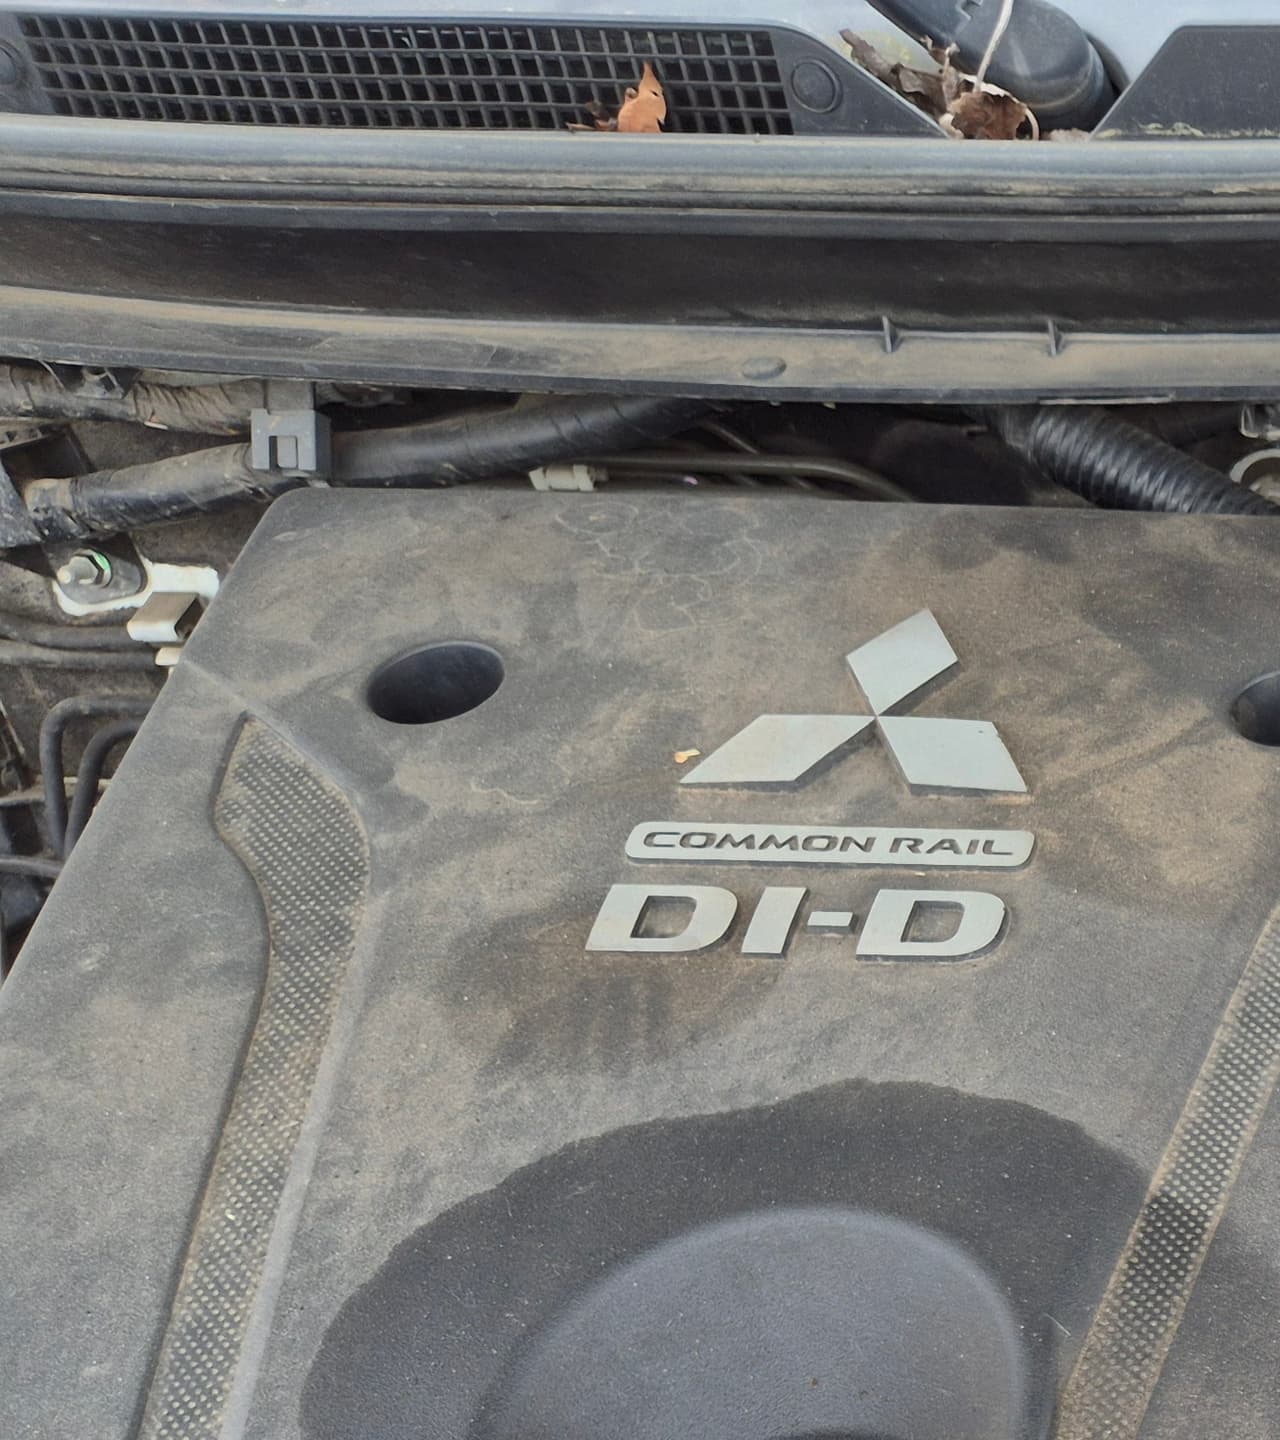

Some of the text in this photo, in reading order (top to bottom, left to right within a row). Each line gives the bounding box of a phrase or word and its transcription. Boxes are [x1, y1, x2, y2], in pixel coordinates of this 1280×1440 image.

[642, 830, 1015, 857] COMMON RAIL
[585, 883, 1007, 957] DI-D
